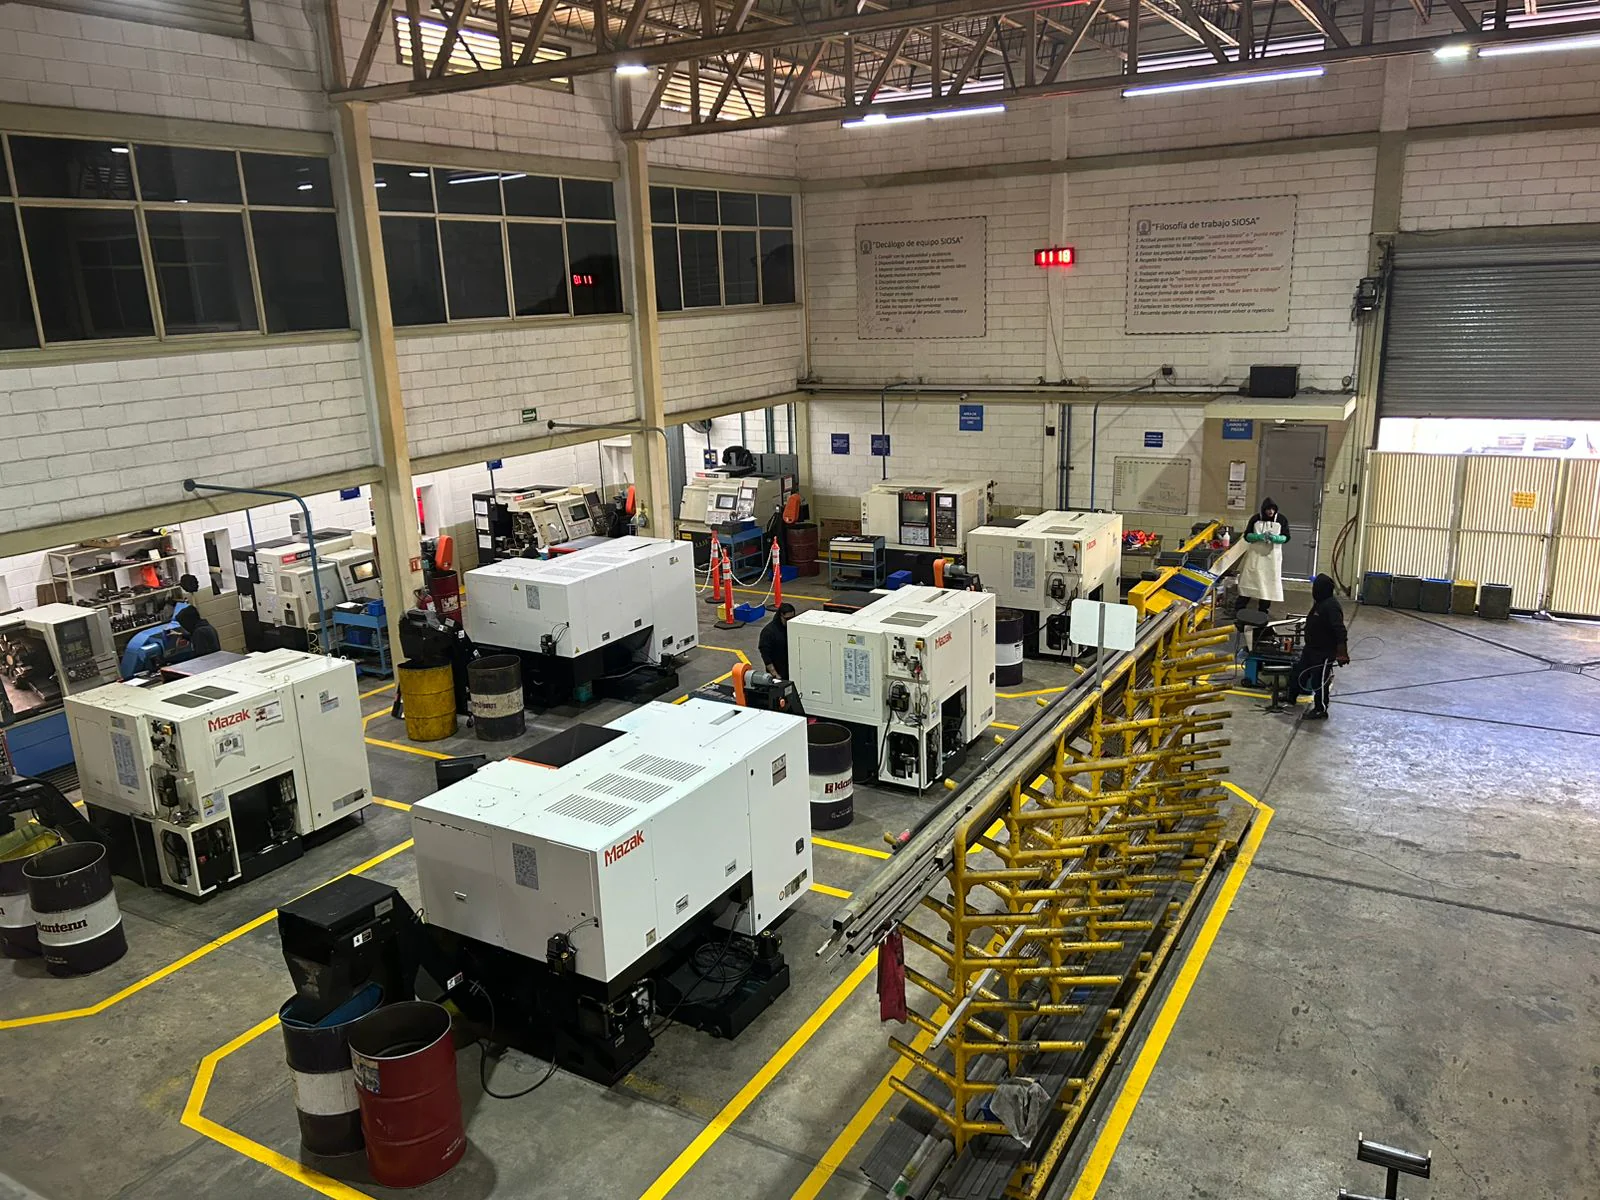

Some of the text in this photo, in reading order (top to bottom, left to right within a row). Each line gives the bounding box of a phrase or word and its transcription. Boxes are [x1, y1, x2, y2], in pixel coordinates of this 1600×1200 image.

[1189, 221, 1199, 229] de
[1201, 219, 1230, 228] trabajo
[916, 238, 939, 247] equipo
[207, 708, 250, 732] Mazak
[604, 829, 645, 867] Mazak
